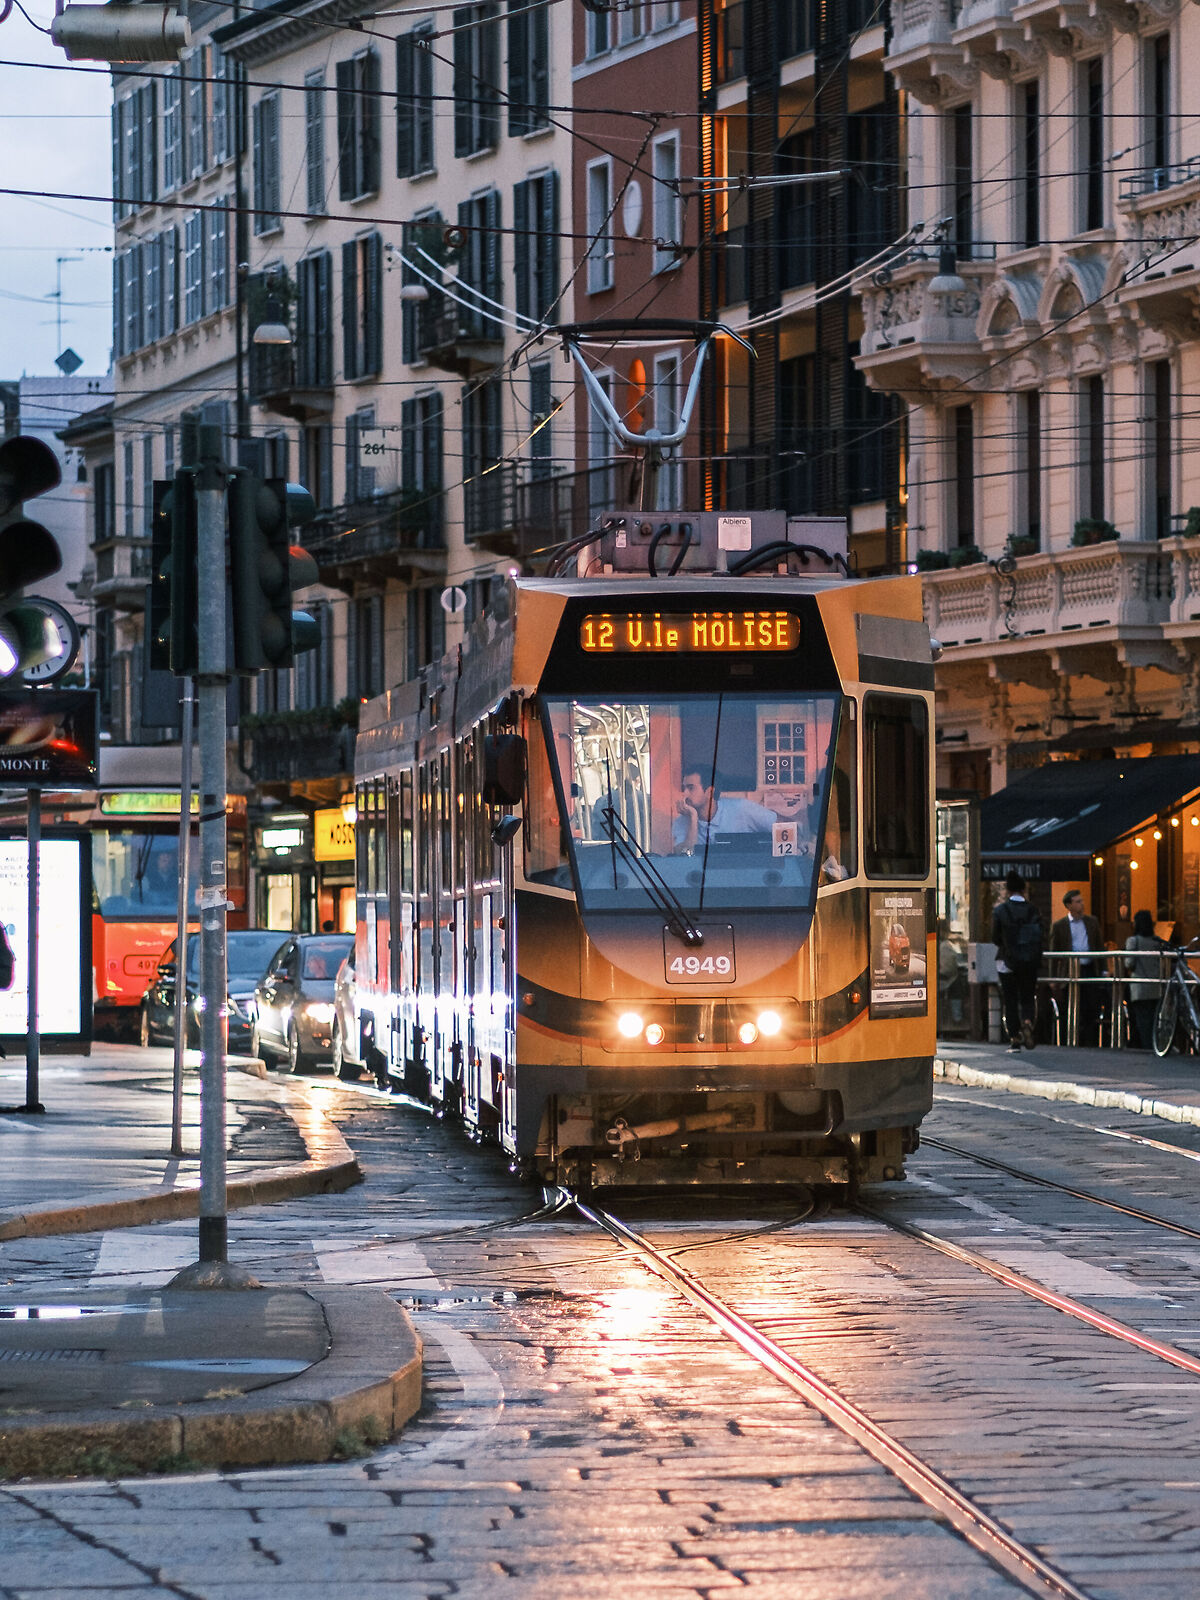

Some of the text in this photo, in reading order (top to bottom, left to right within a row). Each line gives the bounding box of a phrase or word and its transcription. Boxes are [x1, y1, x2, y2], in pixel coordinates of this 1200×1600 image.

[364, 443, 385, 455] 261
[585, 621, 788, 647] 12 V.le MOLISE
[781, 830, 789, 841] 6
[778, 843, 793, 854] 12
[670, 956, 731, 975] 4949
